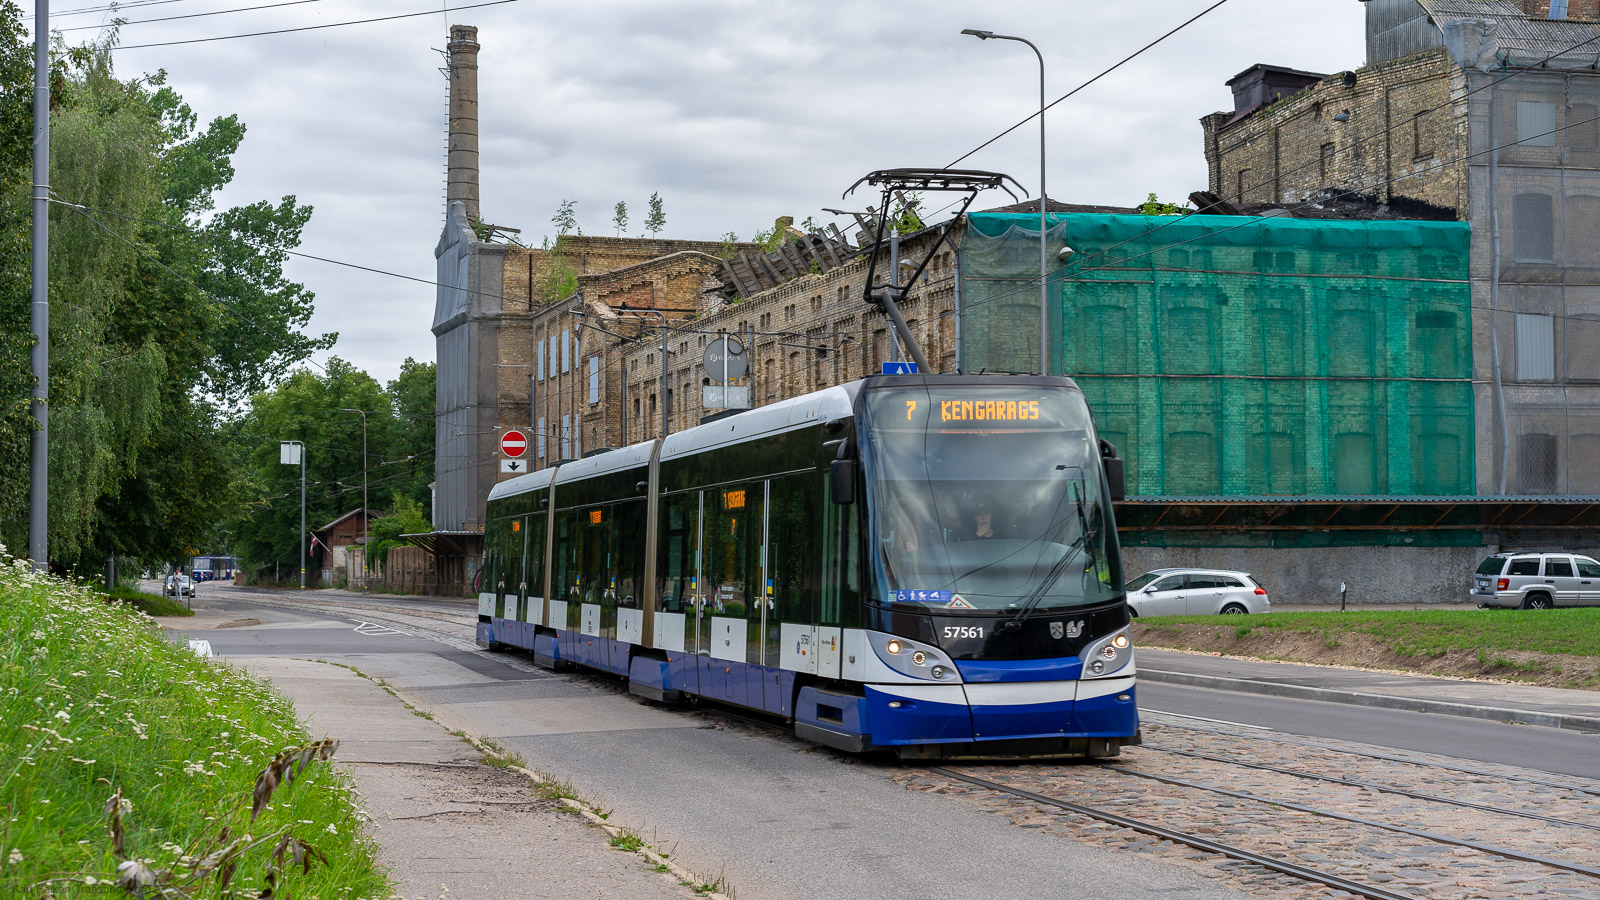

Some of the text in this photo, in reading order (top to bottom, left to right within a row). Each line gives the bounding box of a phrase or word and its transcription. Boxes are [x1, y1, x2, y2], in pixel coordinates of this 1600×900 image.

[906, 400, 1039, 423] 7 ĶENGARAGS
[944, 626, 984, 639] 57561
